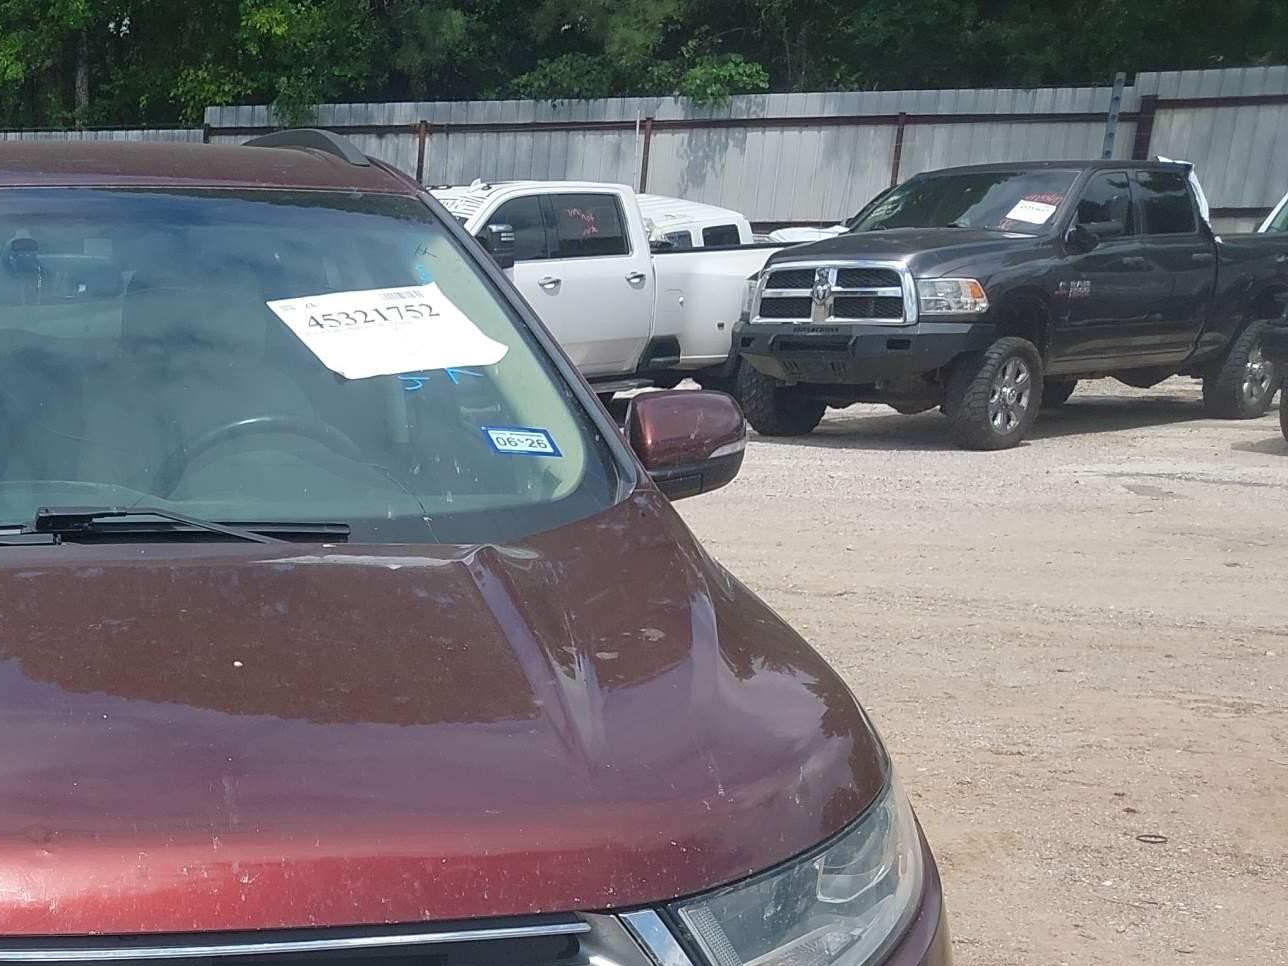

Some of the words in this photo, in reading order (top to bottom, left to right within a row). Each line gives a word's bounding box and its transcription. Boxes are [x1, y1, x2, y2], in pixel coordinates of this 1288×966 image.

[307, 303, 441, 330] 45321752
[495, 436, 518, 447] 06
[527, 438, 548, 449] 26
